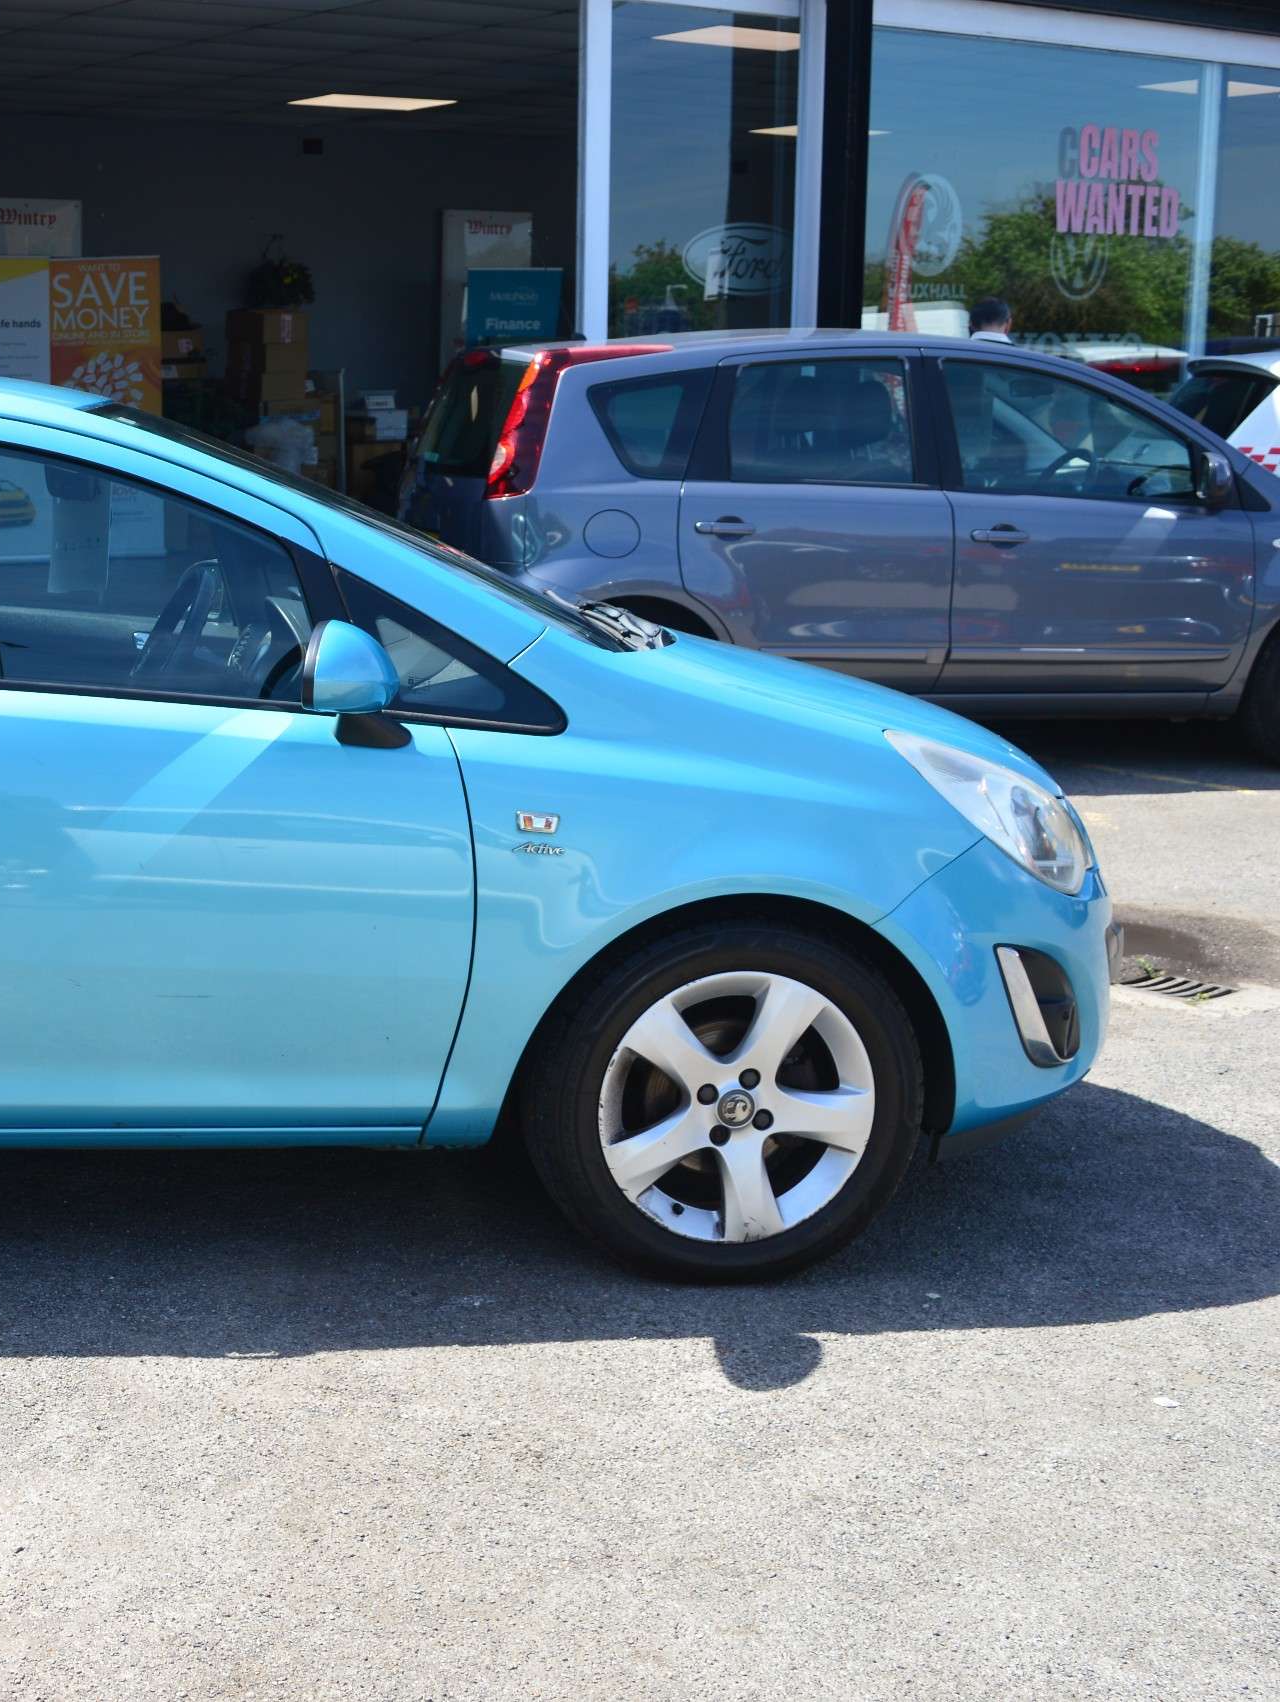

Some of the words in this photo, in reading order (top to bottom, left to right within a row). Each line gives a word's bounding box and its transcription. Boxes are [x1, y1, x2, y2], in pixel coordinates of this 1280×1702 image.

[1055, 179, 1180, 239] WANTED
[713, 235, 787, 280] Ford
[52, 271, 150, 309] SAVE
[12, 318, 42, 329] hands
[54, 306, 149, 331] MONEY
[484, 317, 542, 332] Finance
[511, 841, 566, 856] Active
